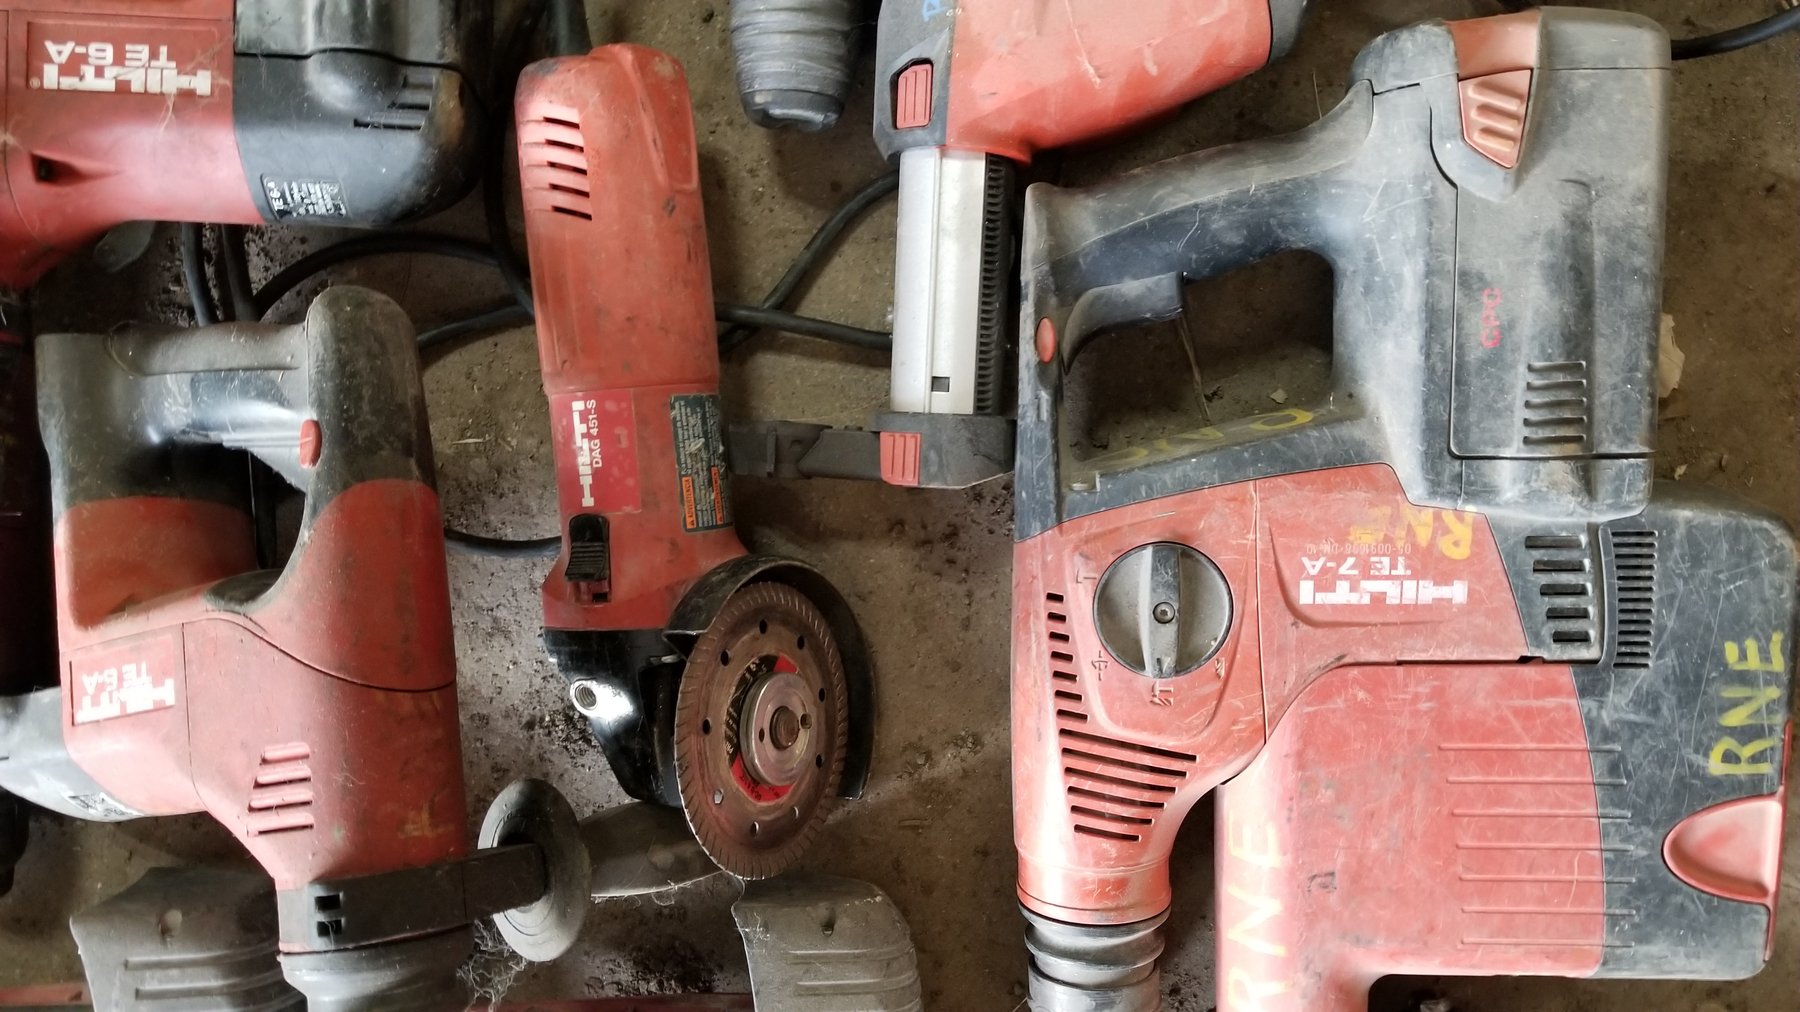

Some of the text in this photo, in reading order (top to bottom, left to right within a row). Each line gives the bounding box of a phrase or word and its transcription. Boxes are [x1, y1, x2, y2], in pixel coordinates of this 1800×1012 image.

[44, 40, 177, 69] TE 6-A
[43, 63, 212, 97] HILTI
[586, 399, 603, 468] DAG 451-S
[571, 400, 595, 508] HILTI
[1301, 556, 1412, 576] TE 7-A
[1299, 579, 1469, 605] HILTI
[121, 661, 153, 688] TE
[1708, 630, 1784, 776] RNE
[1227, 808, 1290, 1012] RNE
